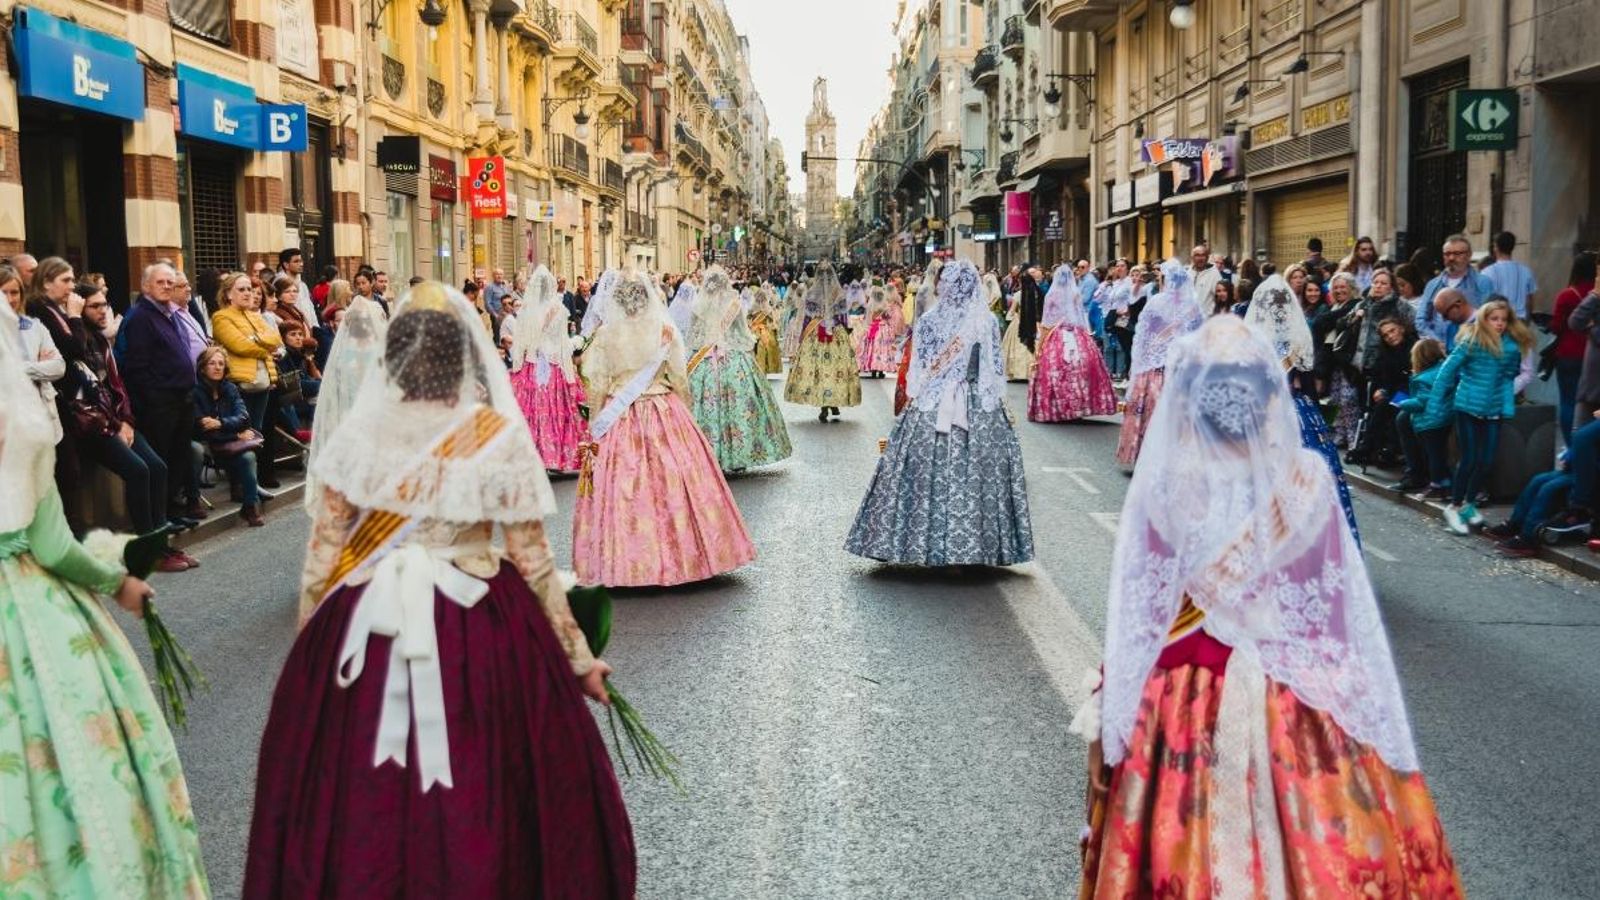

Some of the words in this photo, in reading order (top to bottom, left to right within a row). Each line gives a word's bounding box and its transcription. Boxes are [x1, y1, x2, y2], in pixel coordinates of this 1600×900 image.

[270, 112, 292, 143] B
[1466, 132, 1504, 143] express
[475, 195, 503, 208] nest
